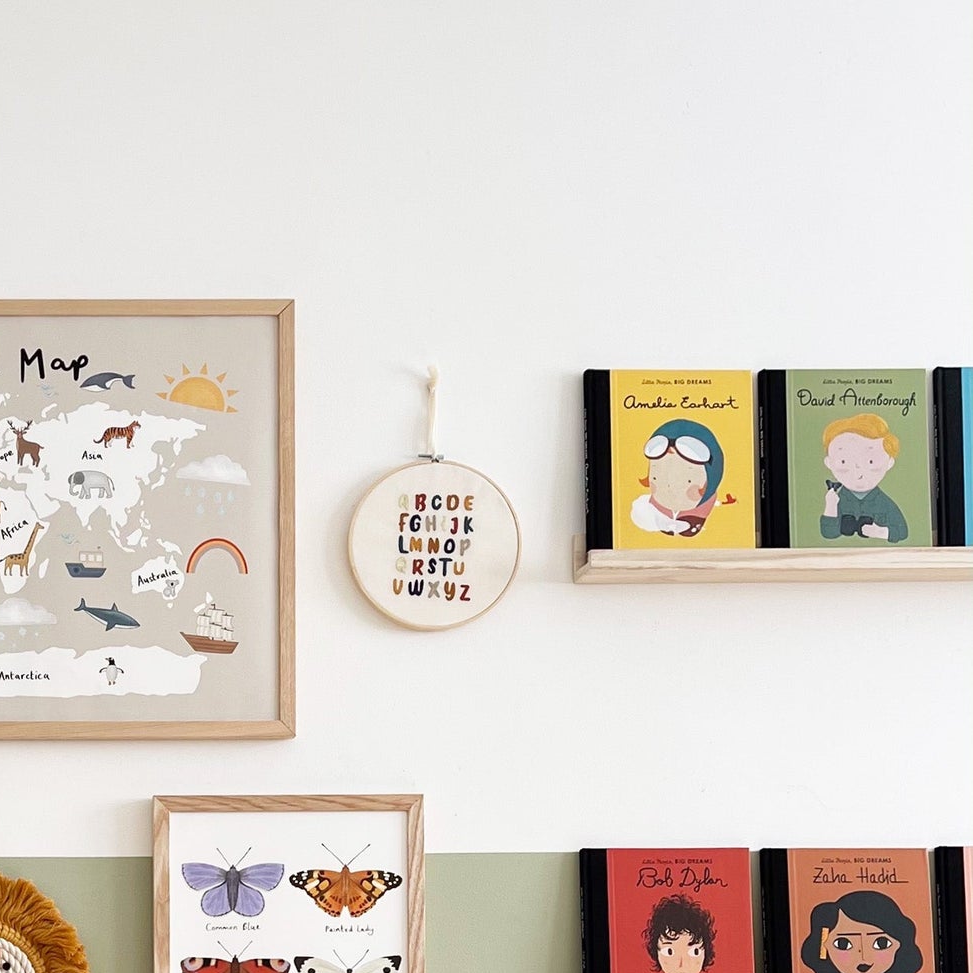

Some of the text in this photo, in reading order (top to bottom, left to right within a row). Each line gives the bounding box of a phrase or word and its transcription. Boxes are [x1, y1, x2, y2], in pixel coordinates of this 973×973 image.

[20, 348, 89, 383] Map
[623, 394, 740, 410] Amelia Earhart
[796, 387, 917, 417] David Attenborough
[81, 450, 103, 460] Asia
[0, 519, 29, 541] Africa
[137, 569, 179, 587] Australia
[636, 866, 728, 893] Bob Dylan
[813, 867, 910, 885] Zaha Hadid
[205, 921, 261, 931] Common Blue
[325, 925, 374, 936] Painted Lady
